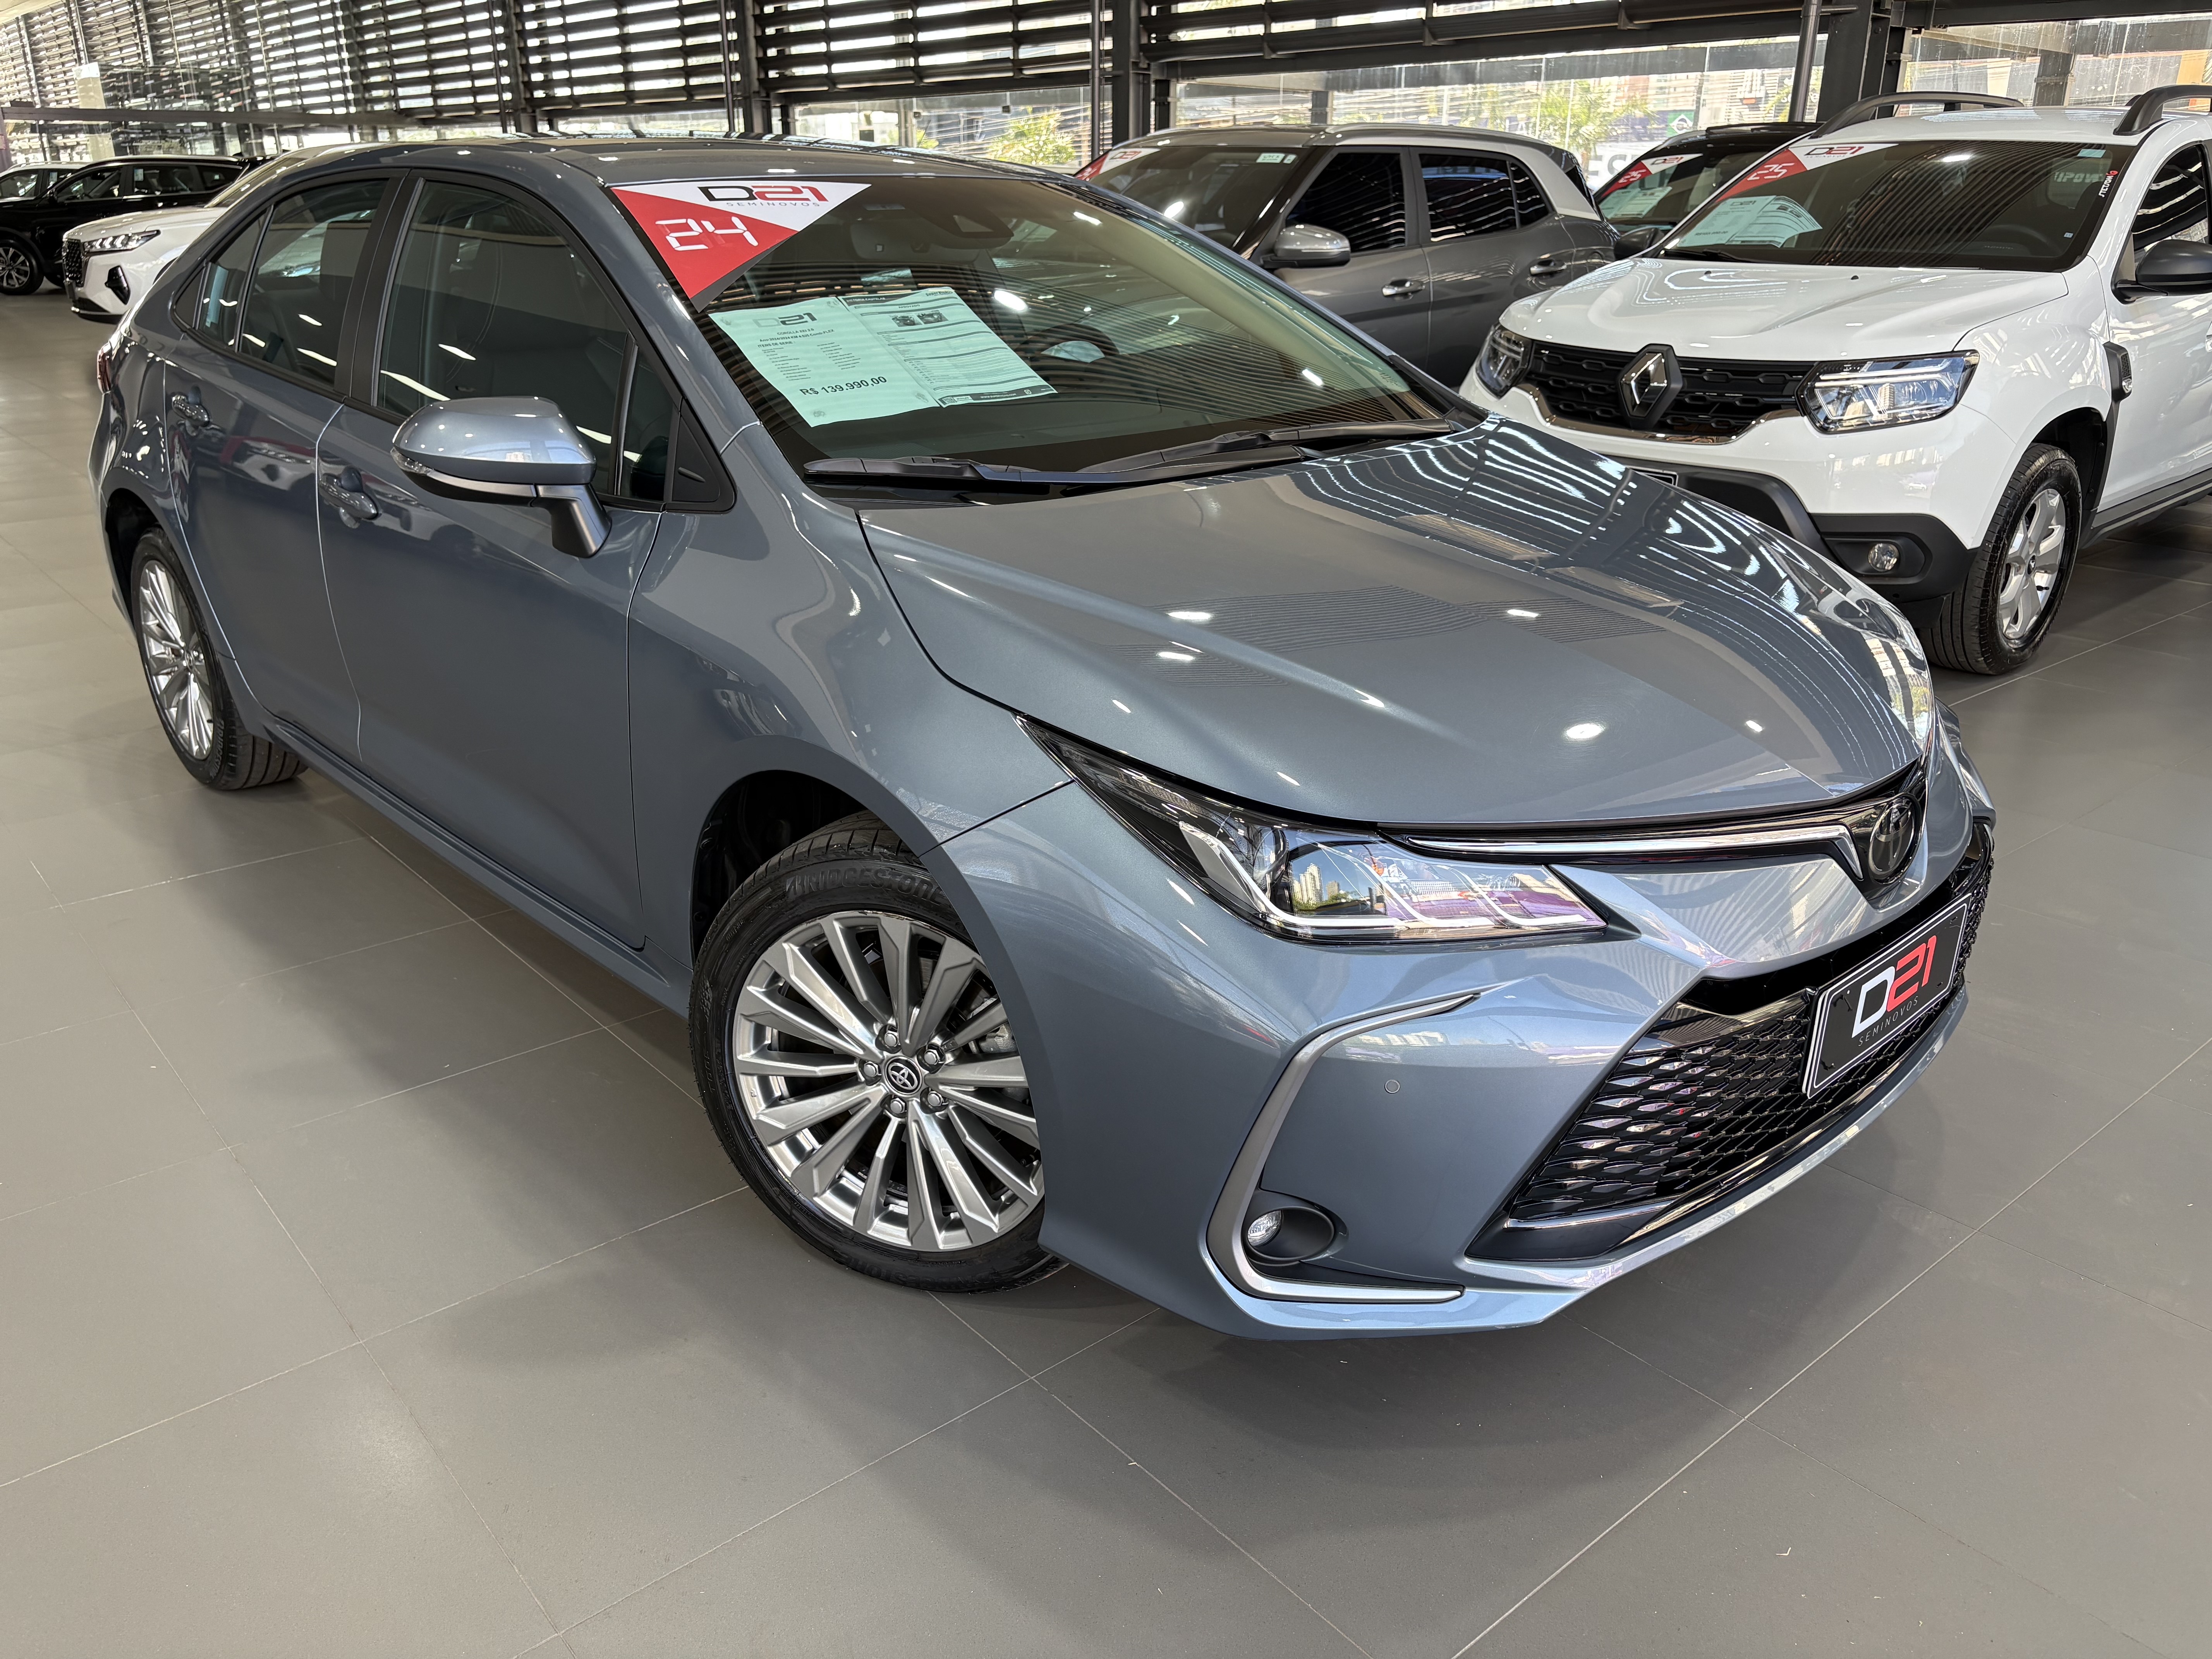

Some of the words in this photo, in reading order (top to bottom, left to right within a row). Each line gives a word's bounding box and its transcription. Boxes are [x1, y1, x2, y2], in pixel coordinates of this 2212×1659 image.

[1805, 146, 1865, 156] D21
[1747, 163, 1795, 181] 25
[697, 185, 829, 201] D21
[655, 216, 758, 251] 24
[752, 313, 817, 328] D21
[821, 376, 887, 393] 139.990,00
[1851, 935, 1937, 1038] D21
[1858, 996, 1918, 1046] SEMINOVOS
